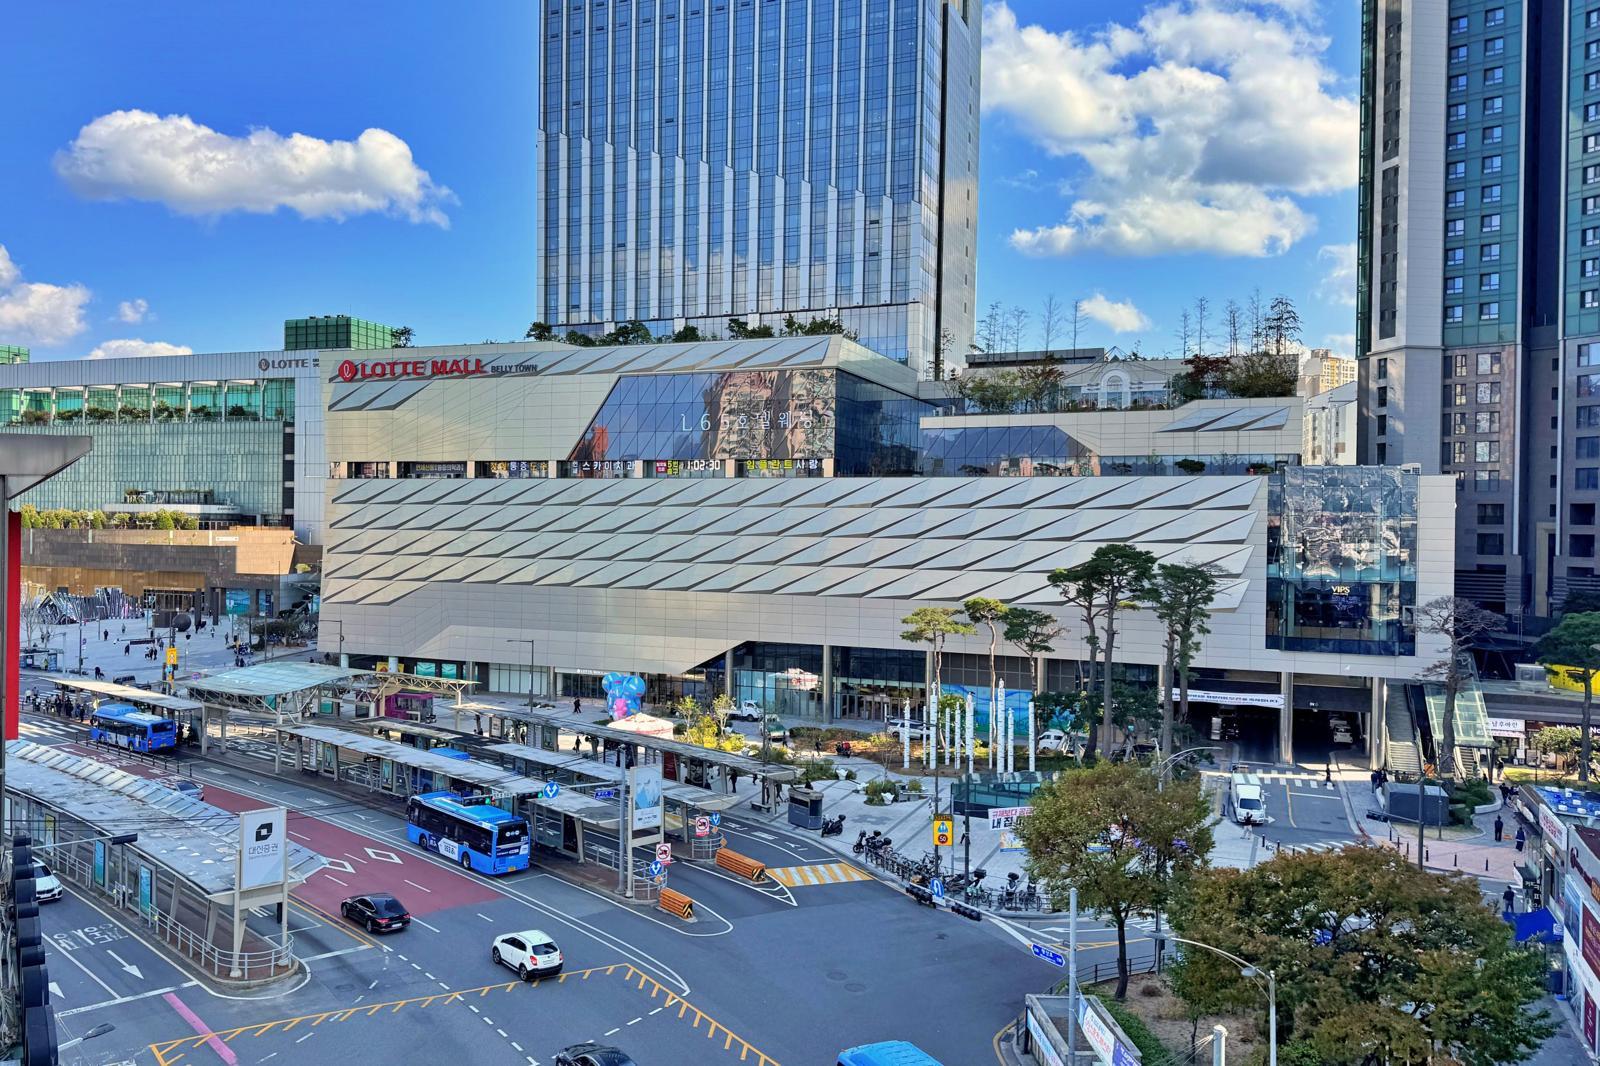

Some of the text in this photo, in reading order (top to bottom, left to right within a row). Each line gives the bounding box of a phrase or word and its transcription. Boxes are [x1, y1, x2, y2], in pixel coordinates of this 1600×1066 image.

[271, 358, 309, 369] LOTTE
[360, 358, 538, 379] LOTTE MALL BELLY TOWN
[992, 818, 1002, 829] 내
